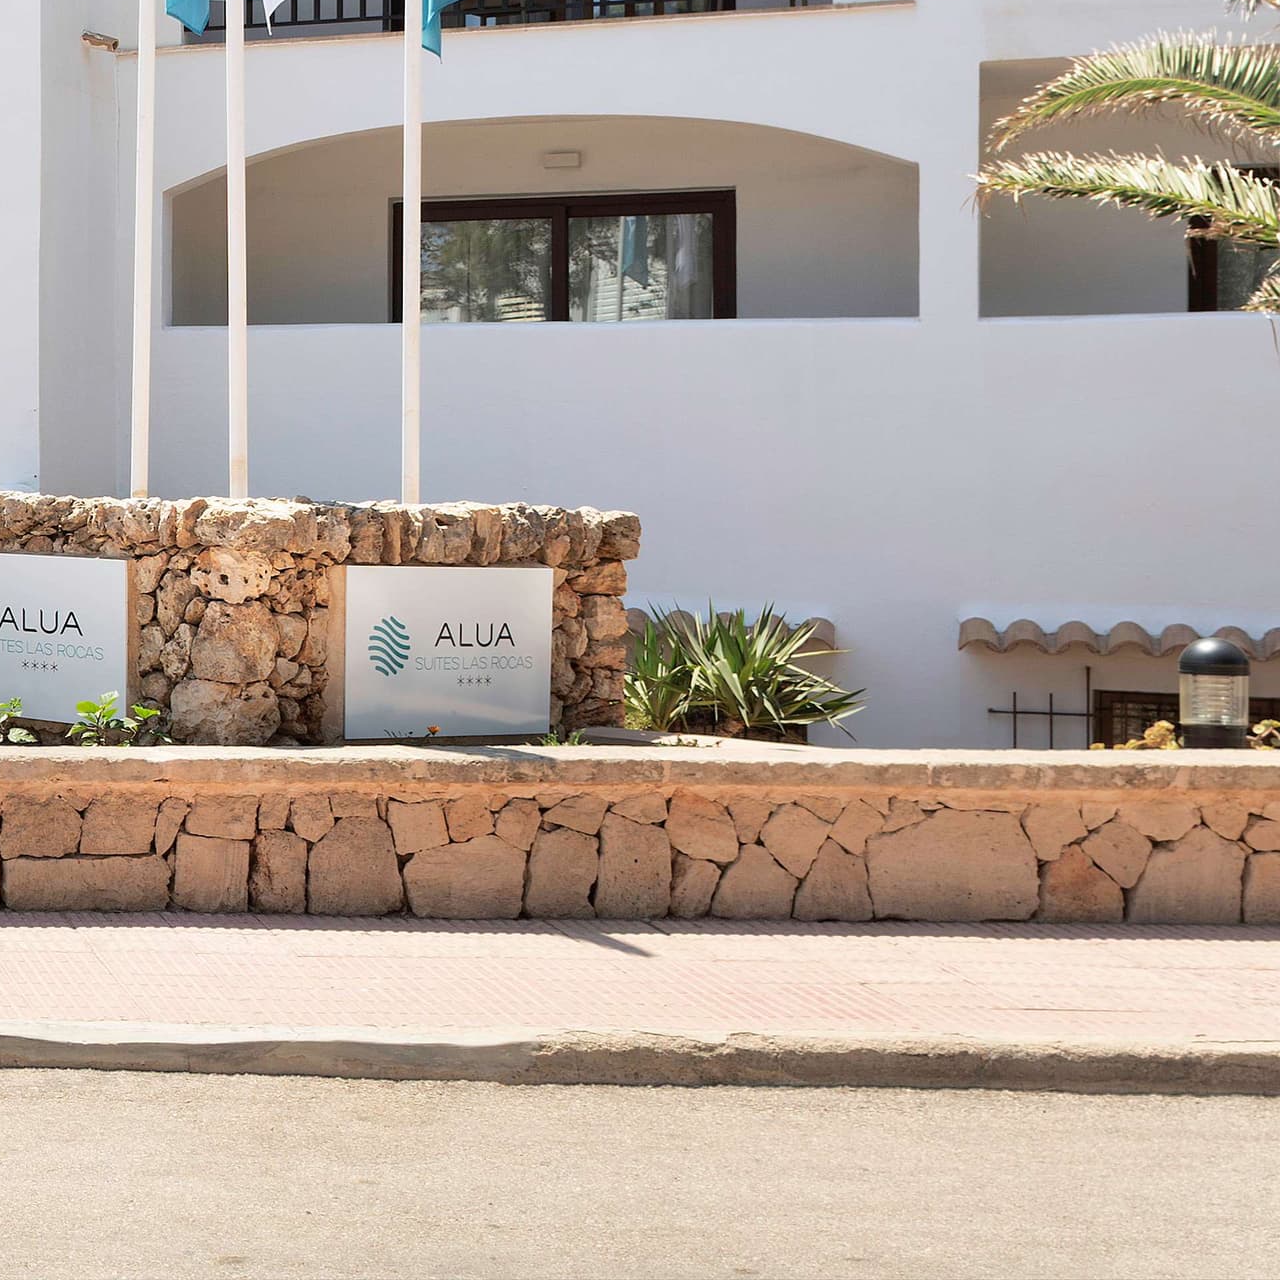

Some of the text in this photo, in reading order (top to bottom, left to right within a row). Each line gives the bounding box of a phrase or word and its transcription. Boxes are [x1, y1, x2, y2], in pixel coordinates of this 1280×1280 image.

[434, 622, 516, 647] ALUA
[26, 641, 53, 656] LAS
[56, 644, 104, 661] ROCAS
[415, 656, 533, 670] SUITES LAS ROCAS
